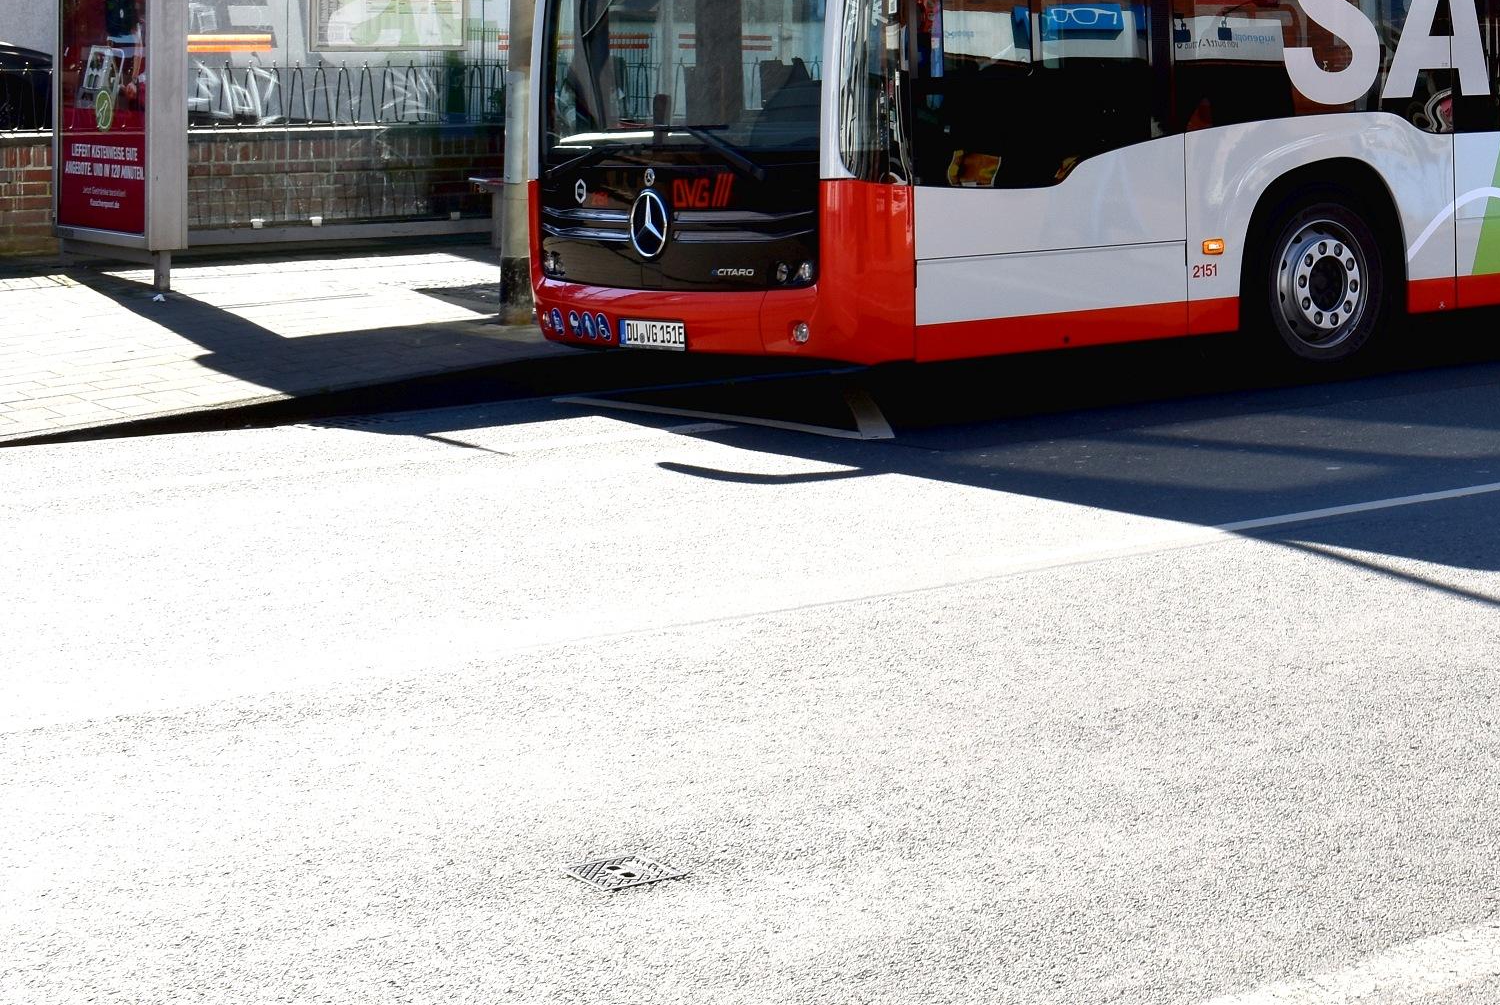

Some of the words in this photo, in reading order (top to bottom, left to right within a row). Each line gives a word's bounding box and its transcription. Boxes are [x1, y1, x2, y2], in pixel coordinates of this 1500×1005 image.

[125, 147, 138, 162] GUTE
[93, 162, 103, 177] UND
[103, 163, 111, 178] IN
[111, 164, 121, 179] 120
[672, 177, 711, 209] DVG
[1192, 263, 1217, 278] 2151
[626, 322, 639, 341] DU
[645, 324, 658, 344] VG
[660, 325, 685, 345] 151E
